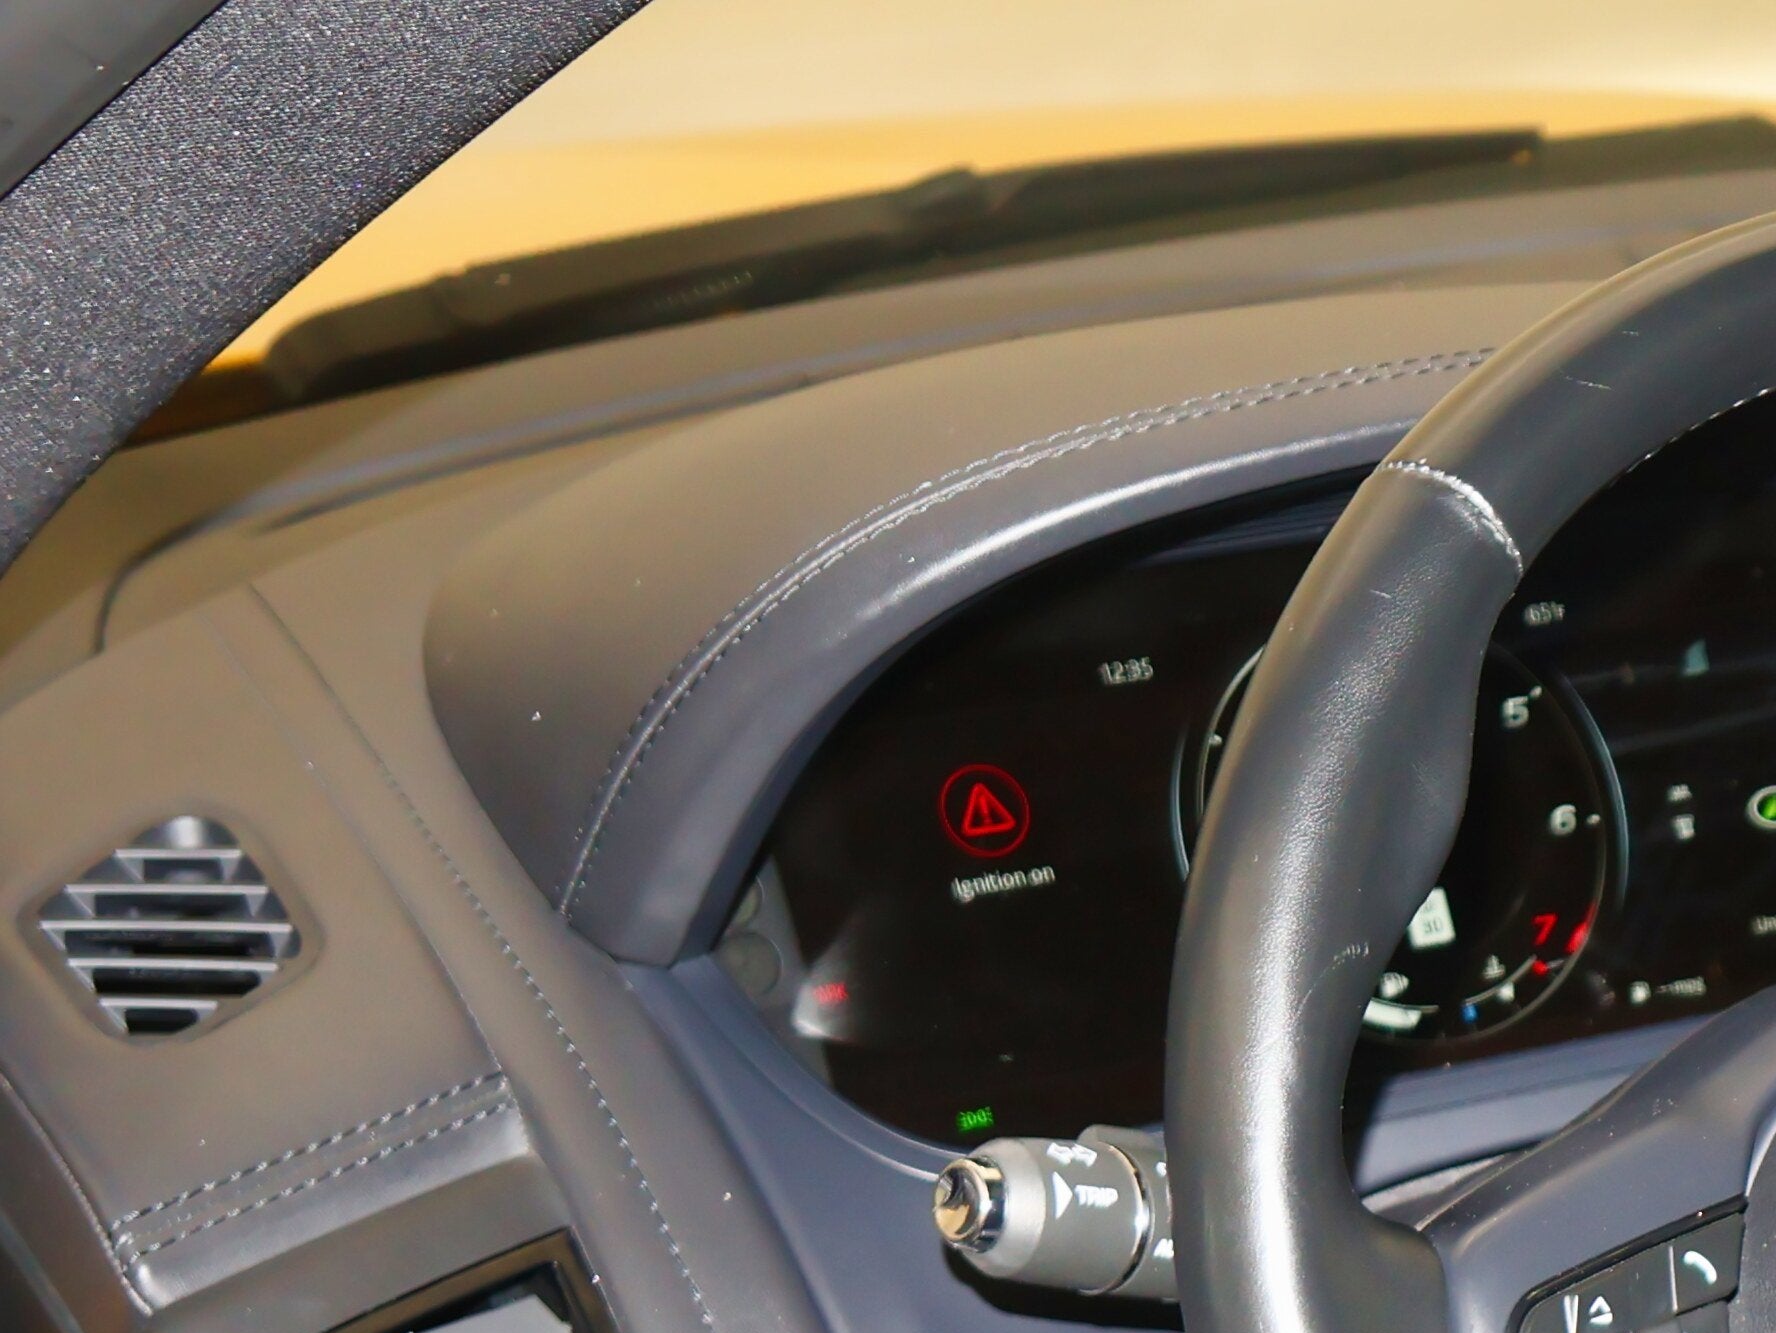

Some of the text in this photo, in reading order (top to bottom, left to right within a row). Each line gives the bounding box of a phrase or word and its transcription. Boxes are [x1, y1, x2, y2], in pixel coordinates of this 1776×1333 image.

[1502, 696, 1529, 728] 5
[1551, 804, 1576, 836] 6
[952, 866, 1055, 902] Ignition on
[1534, 913, 1557, 946] 7
[1074, 1185, 1119, 1208] TRIP
